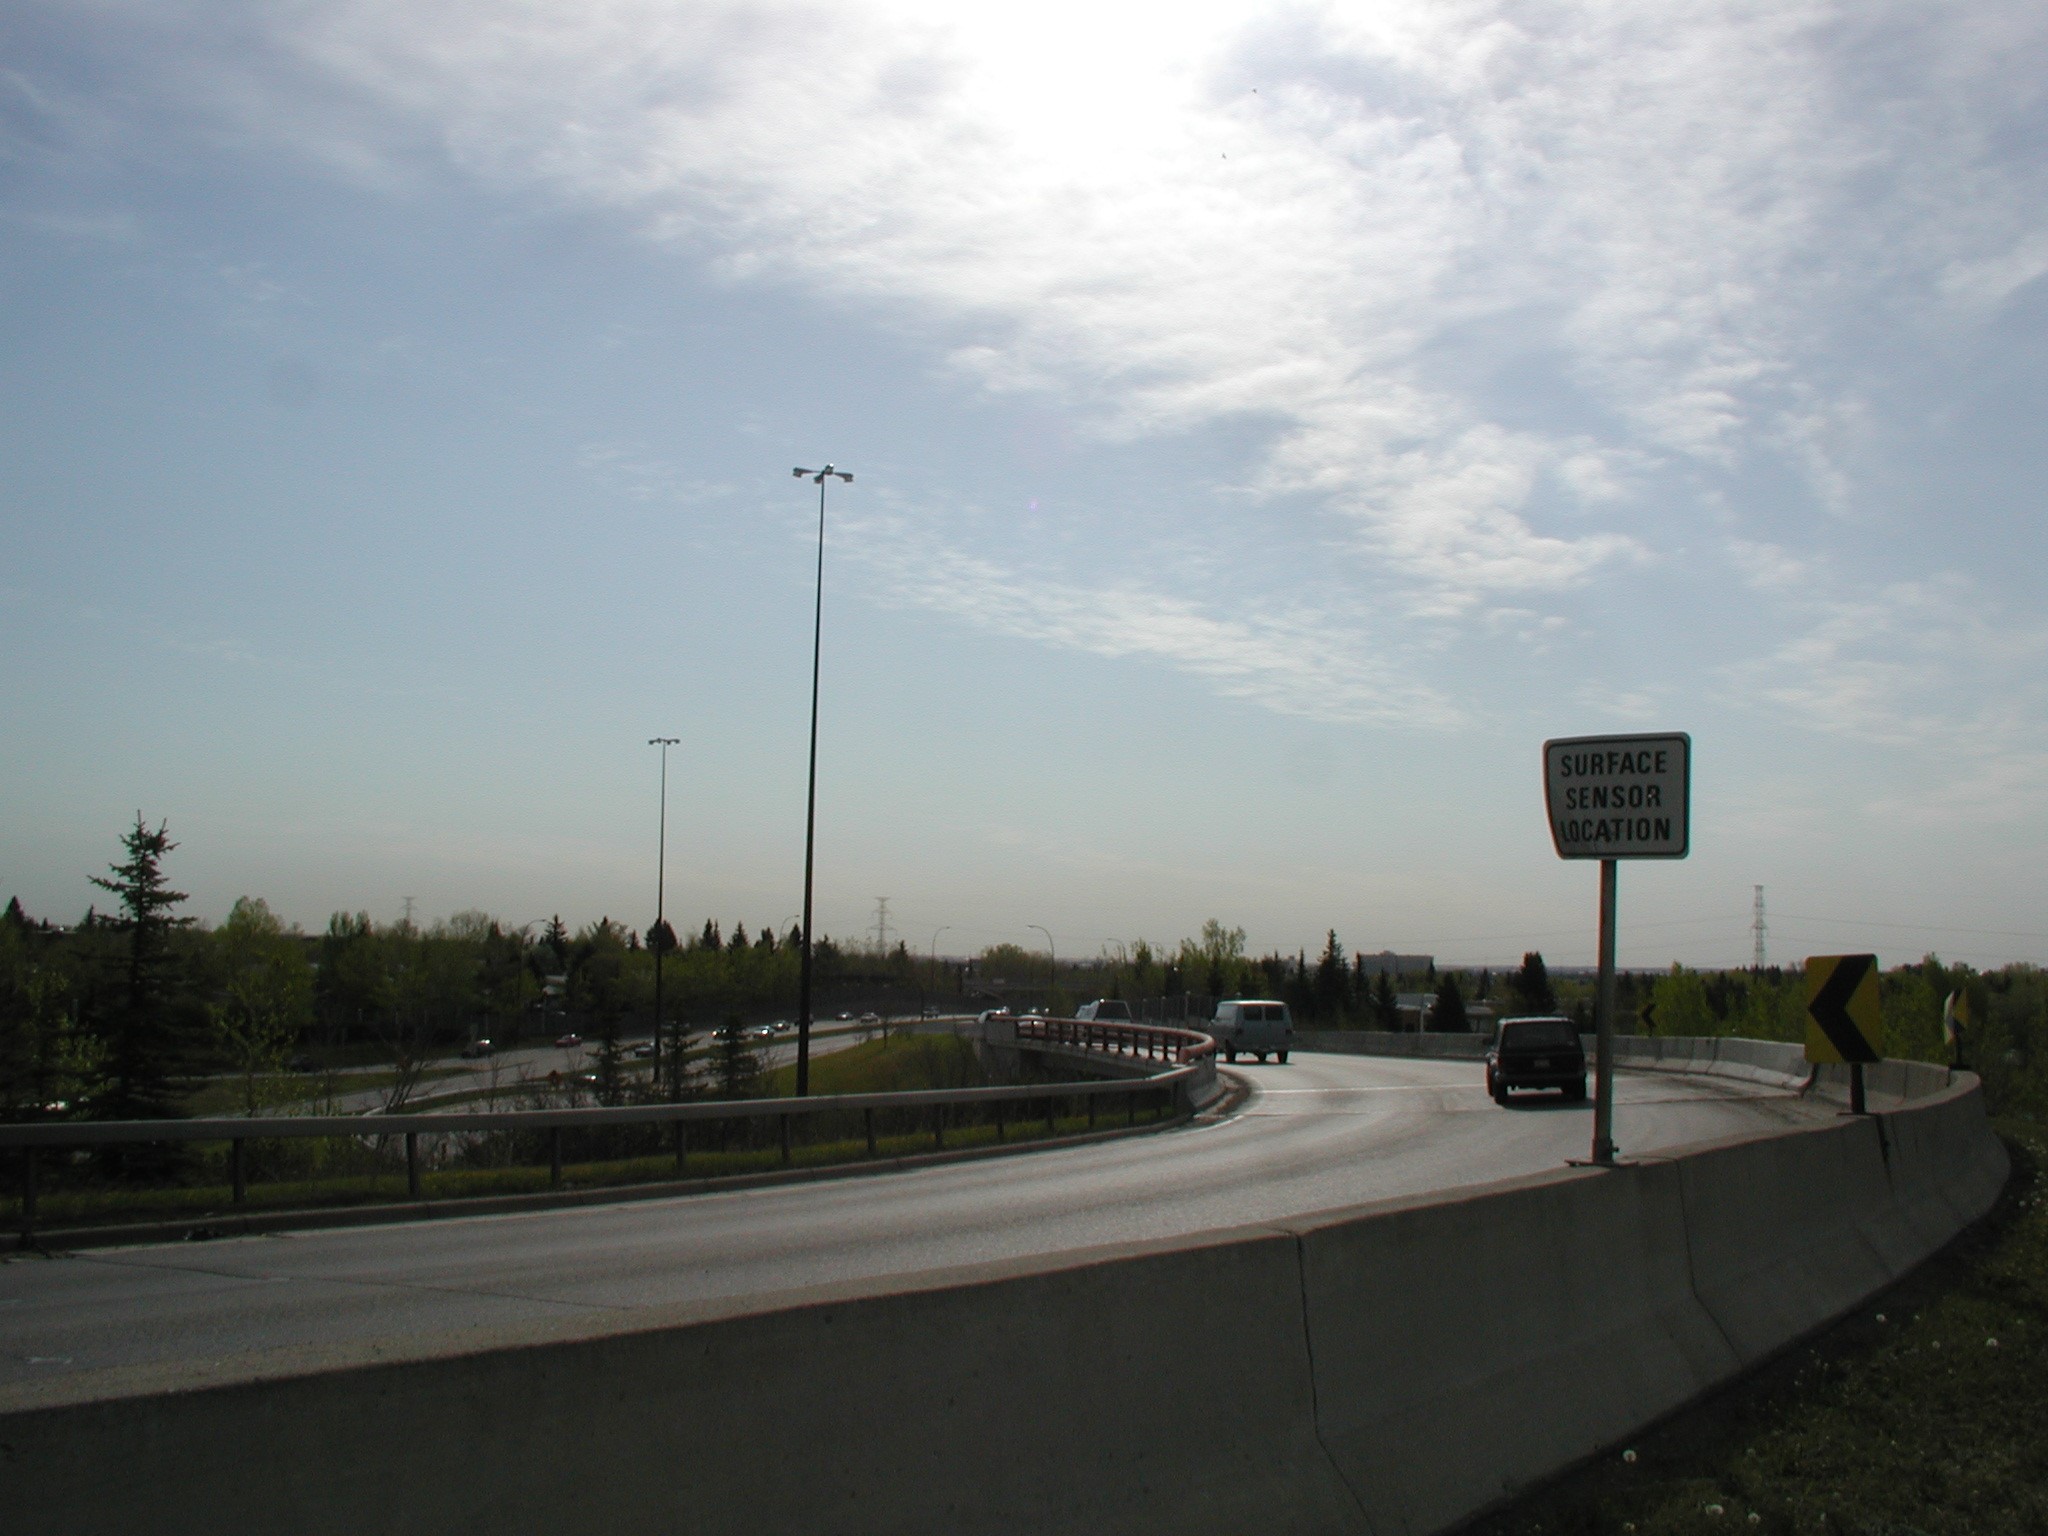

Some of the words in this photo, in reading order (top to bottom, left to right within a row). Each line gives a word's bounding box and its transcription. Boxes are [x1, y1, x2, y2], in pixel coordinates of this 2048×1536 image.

[1561, 751, 1667, 777] SURFACE
[1565, 785, 1661, 810] SENSOR
[1560, 818, 1670, 843] LOCATION
